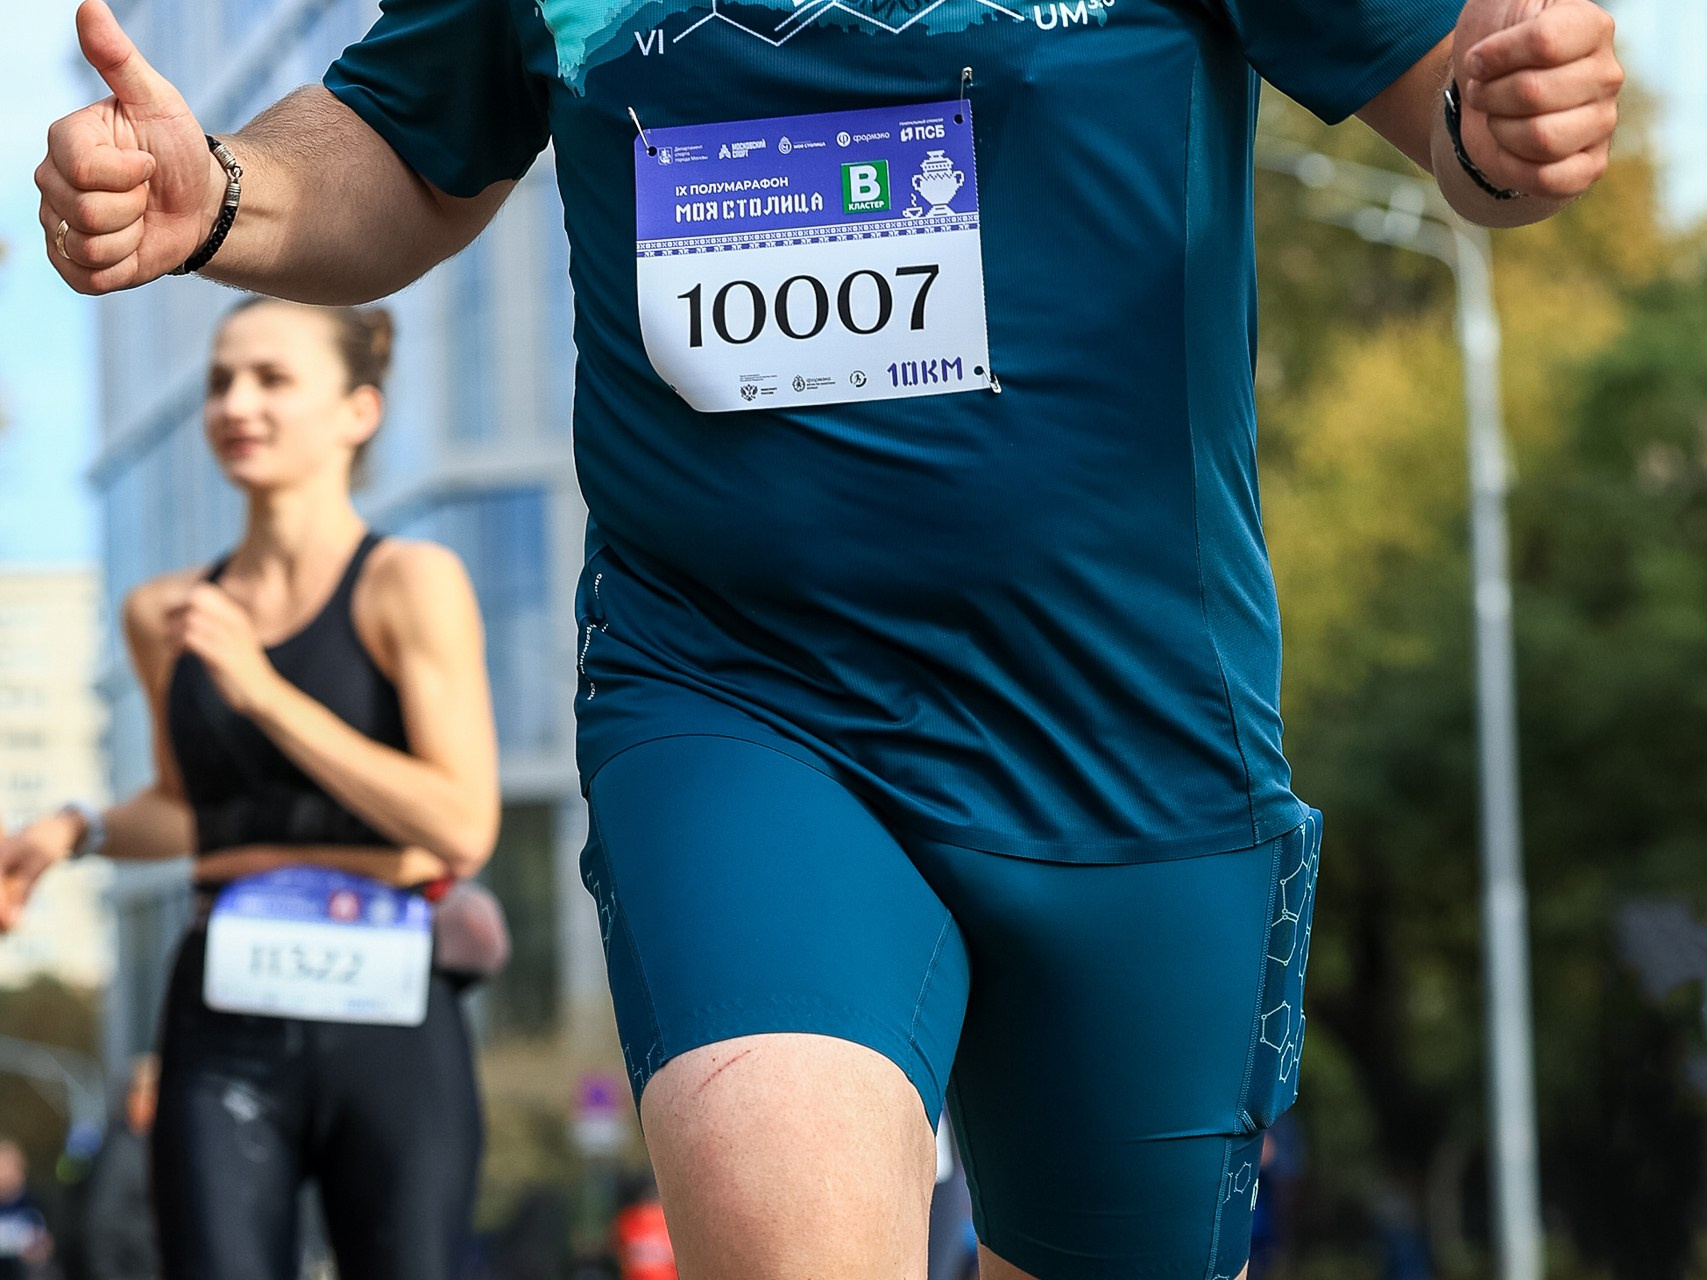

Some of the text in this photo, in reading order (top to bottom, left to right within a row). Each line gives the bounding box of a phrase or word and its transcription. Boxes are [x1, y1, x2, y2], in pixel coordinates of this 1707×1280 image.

[634, 28, 664, 56] VI
[915, 124, 945, 140] ПСБ
[675, 176, 789, 197] IX ПОЛУМАРАФОН
[675, 191, 824, 224] МОЯ СТОЛИЦА
[848, 200, 885, 211] КЛАСТЕР
[676, 263, 940, 349] 10007
